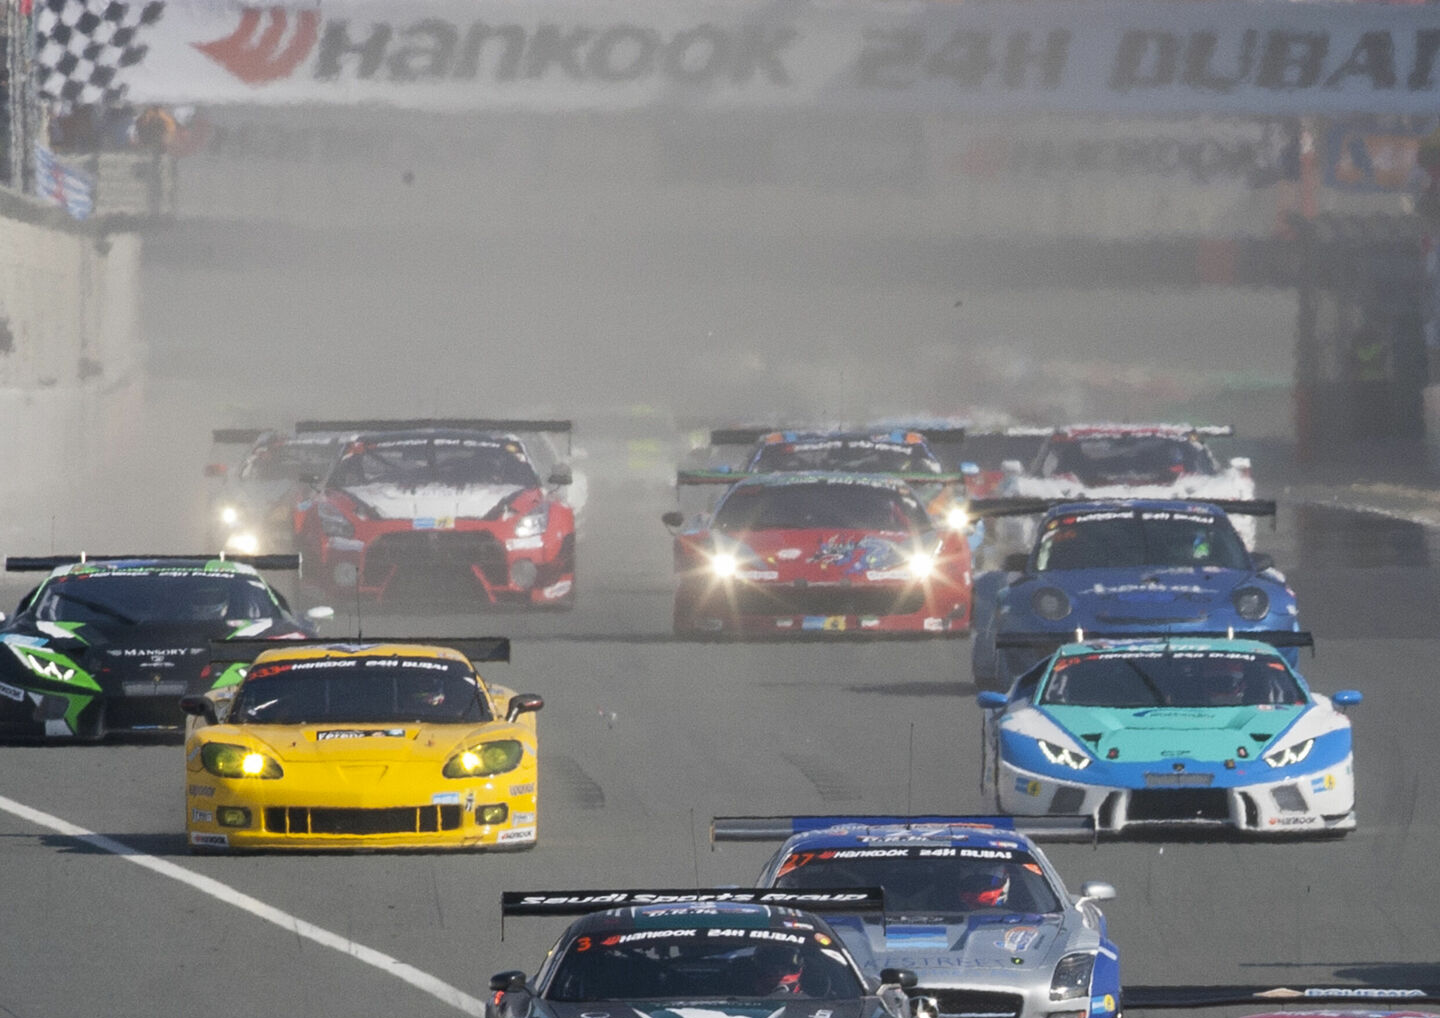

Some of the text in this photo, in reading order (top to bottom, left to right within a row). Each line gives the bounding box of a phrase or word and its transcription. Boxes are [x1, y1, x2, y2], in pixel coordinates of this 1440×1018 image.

[855, 26, 1073, 90] 24H
[520, 891, 869, 905] Saudi Sports Group
[576, 936, 592, 952] 3
[707, 929, 746, 938] 24H
[748, 930, 807, 944] DUBAI
